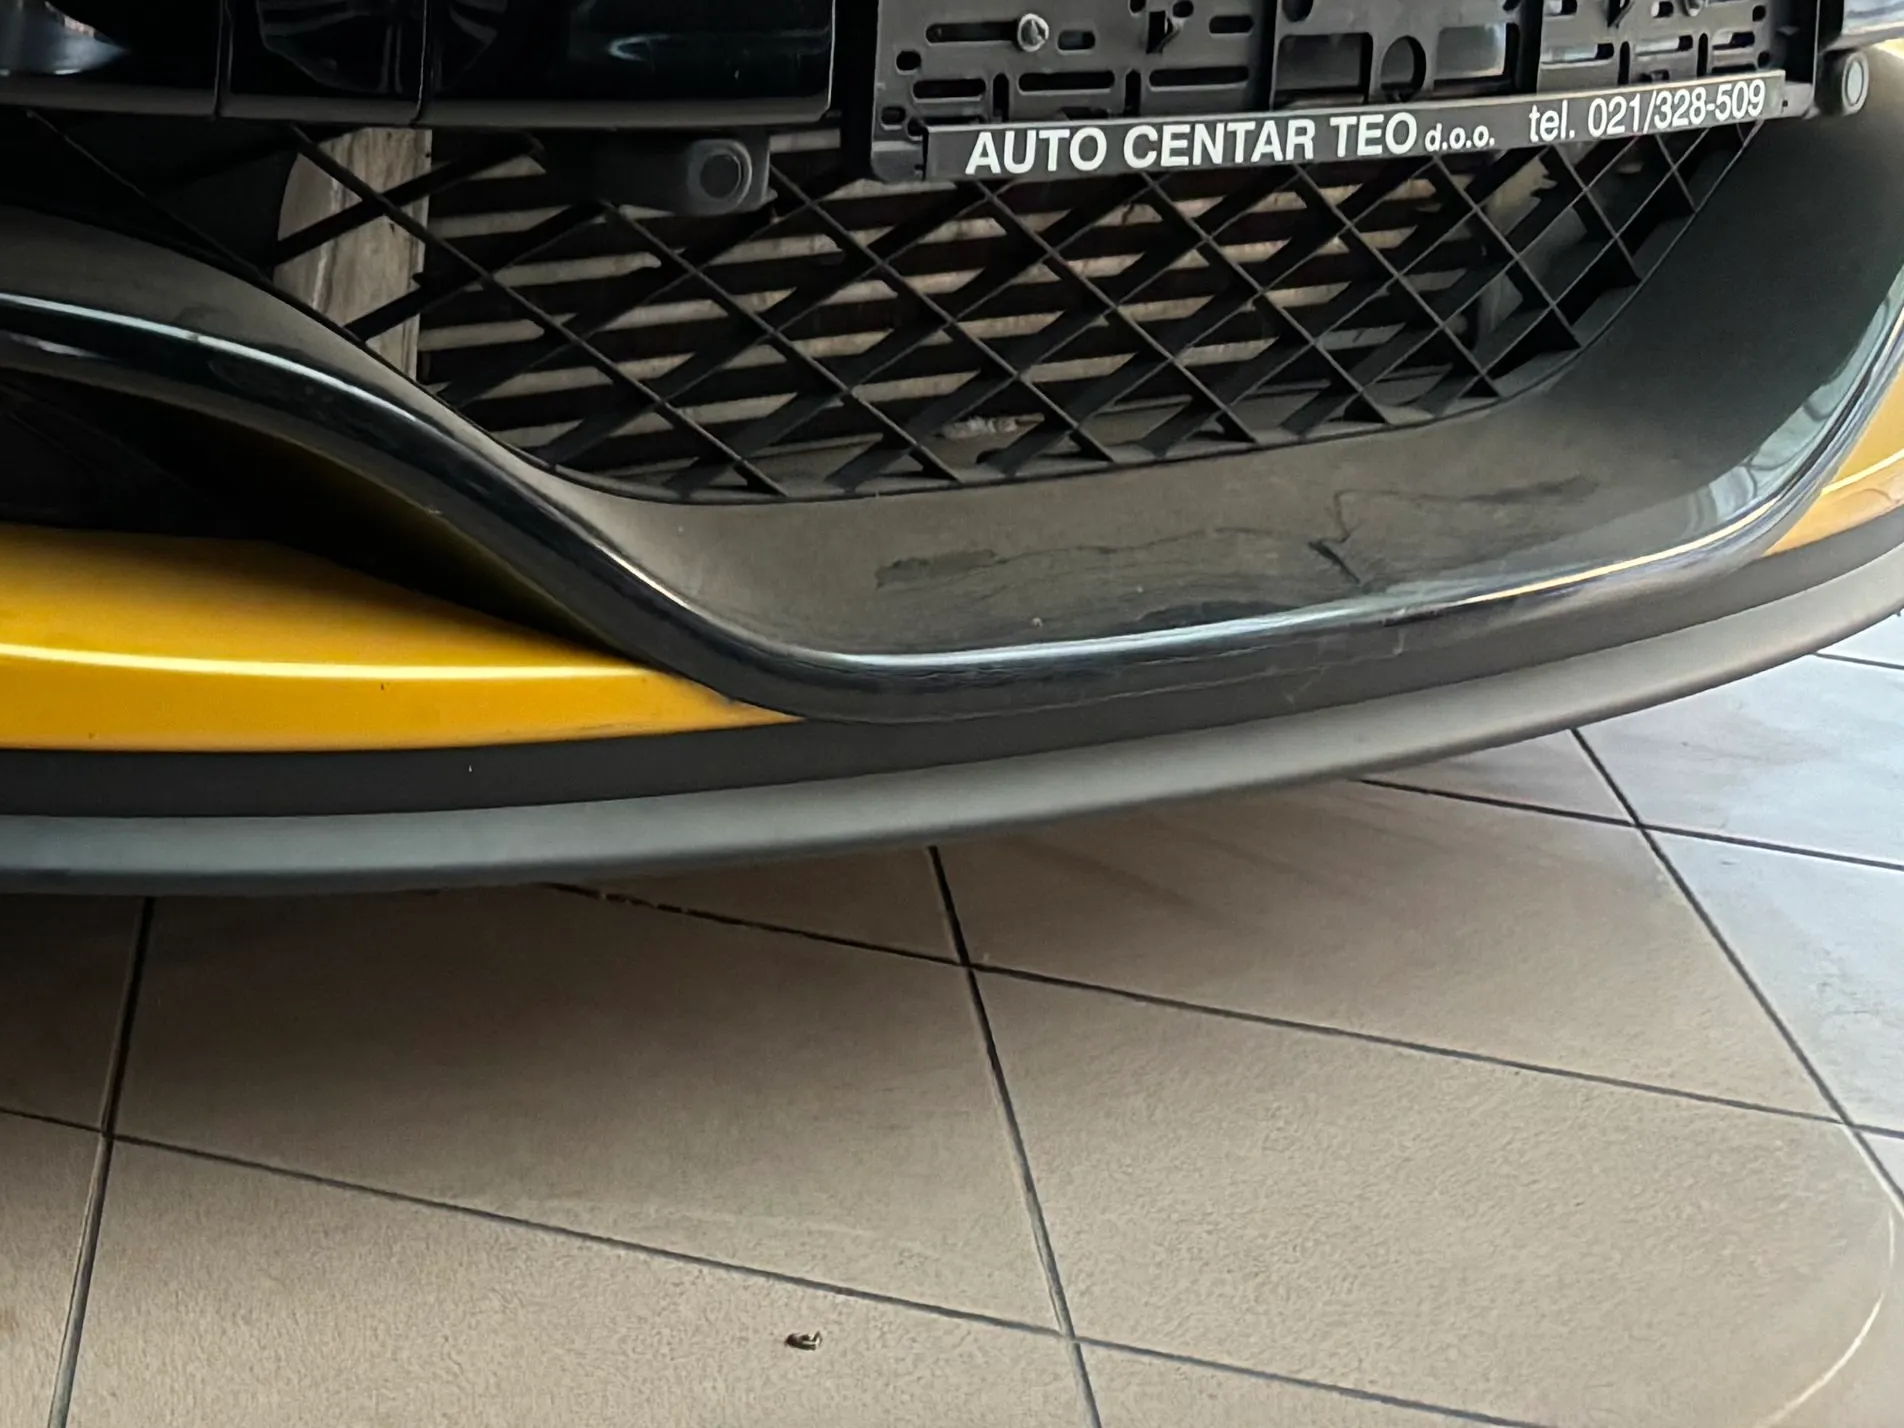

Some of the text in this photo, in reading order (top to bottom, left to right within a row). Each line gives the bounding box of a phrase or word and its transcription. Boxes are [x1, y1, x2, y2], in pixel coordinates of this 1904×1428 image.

[965, 79, 1767, 175] AUTO CENTAR TEO d.o.o. tel. 021/328-509
